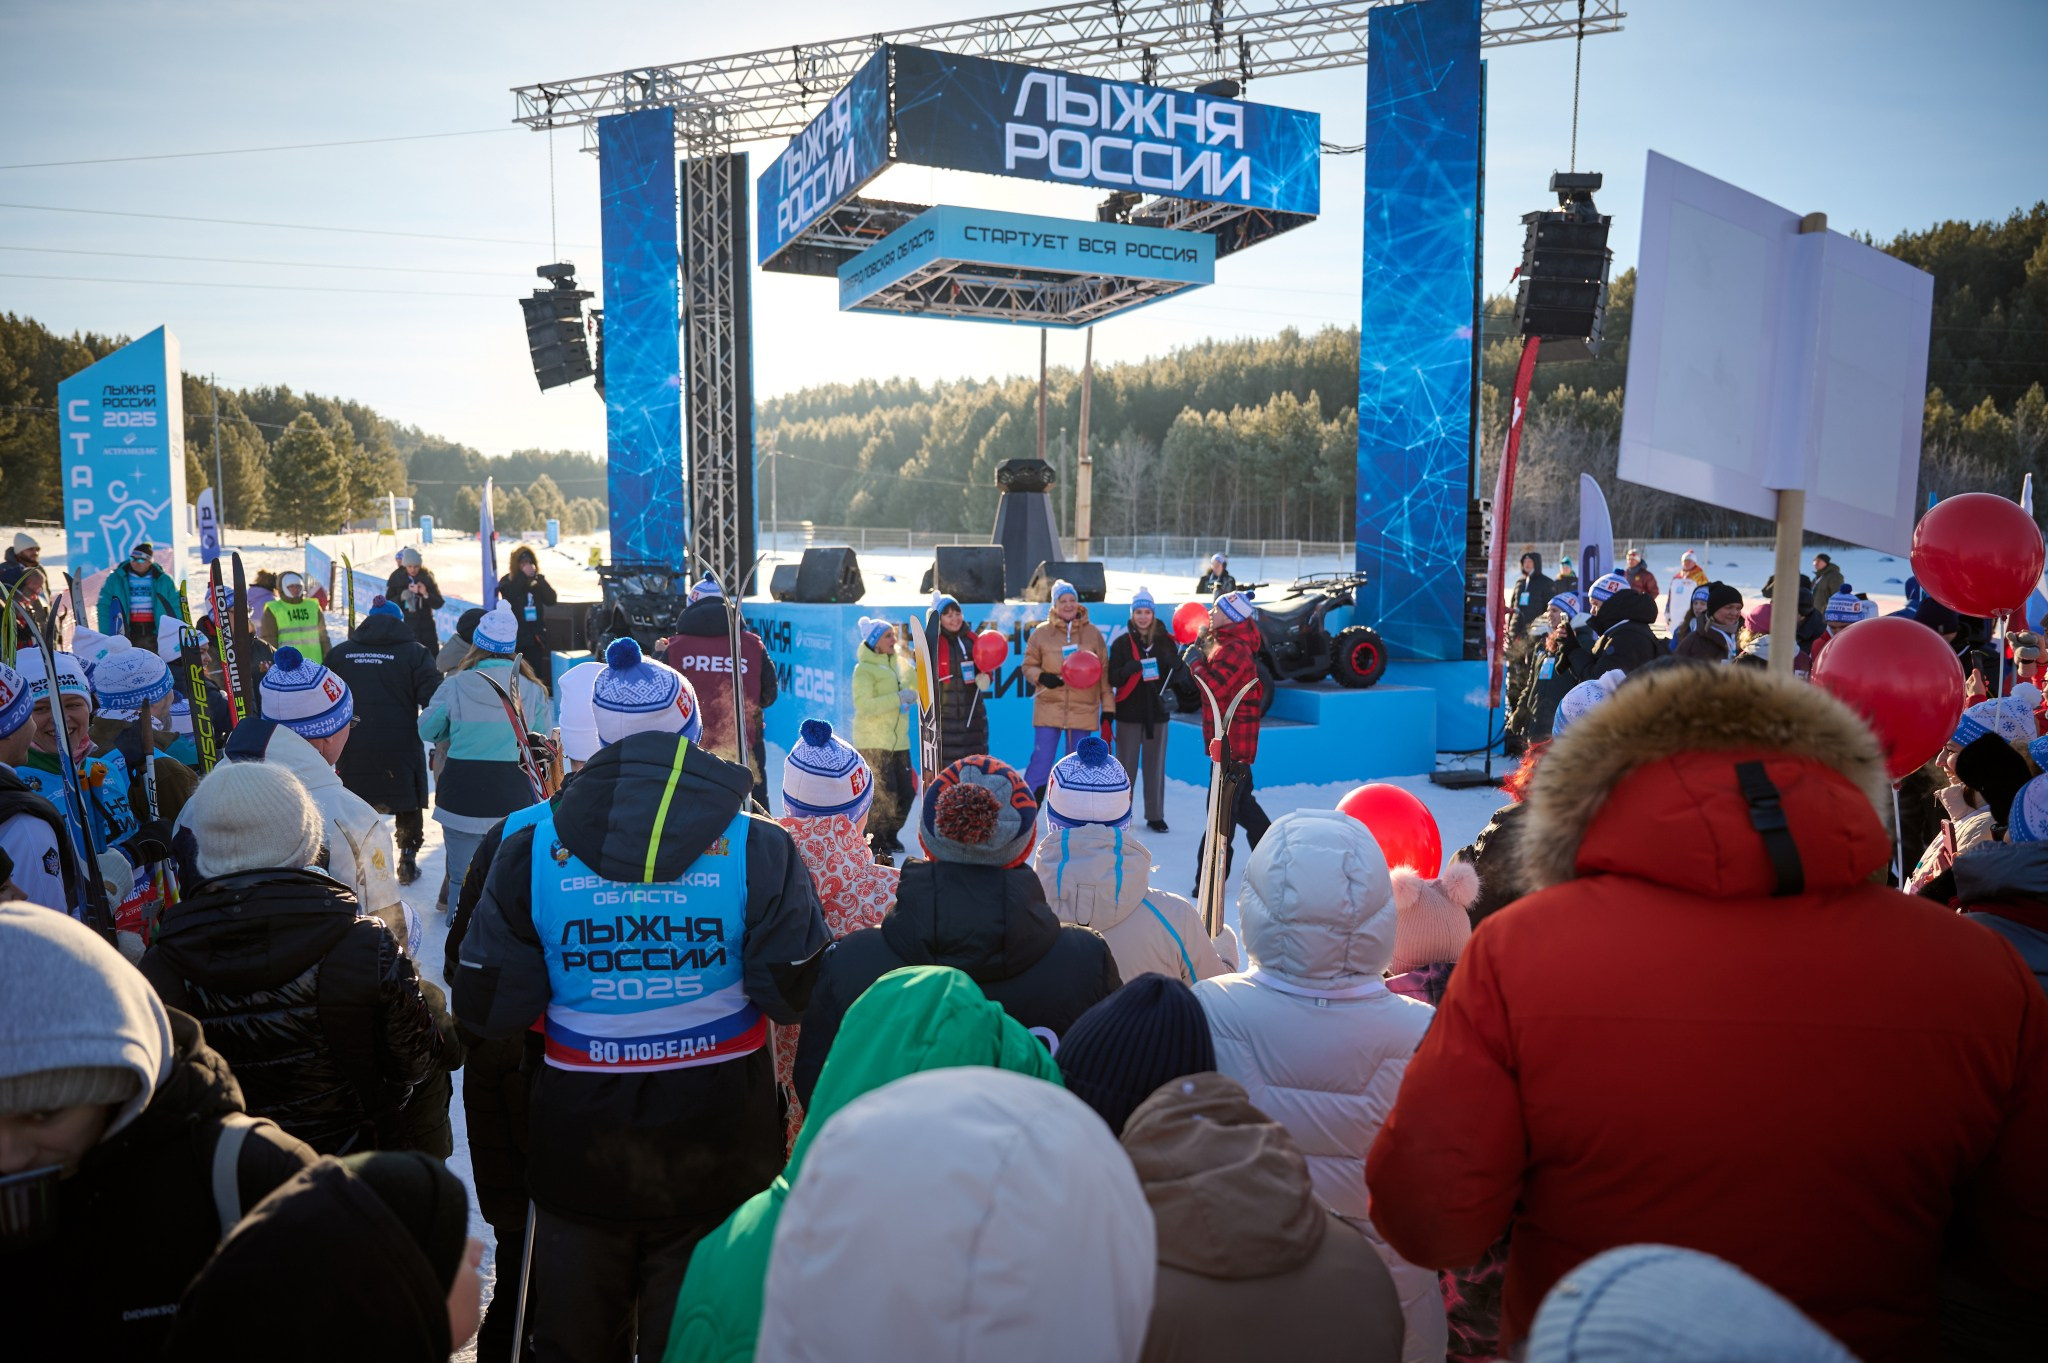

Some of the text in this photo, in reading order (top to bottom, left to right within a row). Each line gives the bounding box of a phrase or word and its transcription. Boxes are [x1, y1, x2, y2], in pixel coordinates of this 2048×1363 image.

[1013, 71, 1245, 150] ЛЫЖНЯ
[779, 86, 851, 198] ЛЫЖНЯ
[1005, 121, 1251, 200] РОССИИ
[777, 137, 856, 244] РОССИИ
[964, 225, 1198, 263] СТАРТУЕТ ВСЯ РОССИЯ
[102, 385, 156, 396] ЛЫЖНЯ
[102, 397, 157, 408] РОССИИ
[103, 411, 157, 427] 2025
[68, 399, 95, 554] СТАРТ
[476, 637, 496, 650] 2025
[682, 655, 748, 674] PRESS
[795, 664, 835, 705] 2025
[593, 890, 687, 905] ОБЛАСТЬ
[561, 915, 724, 946] ЛЫЖНЯ
[562, 948, 727, 972] РОССИИ
[591, 976, 704, 1001] 2025
[589, 1034, 717, 1064] 80 ПОБЕДА!
